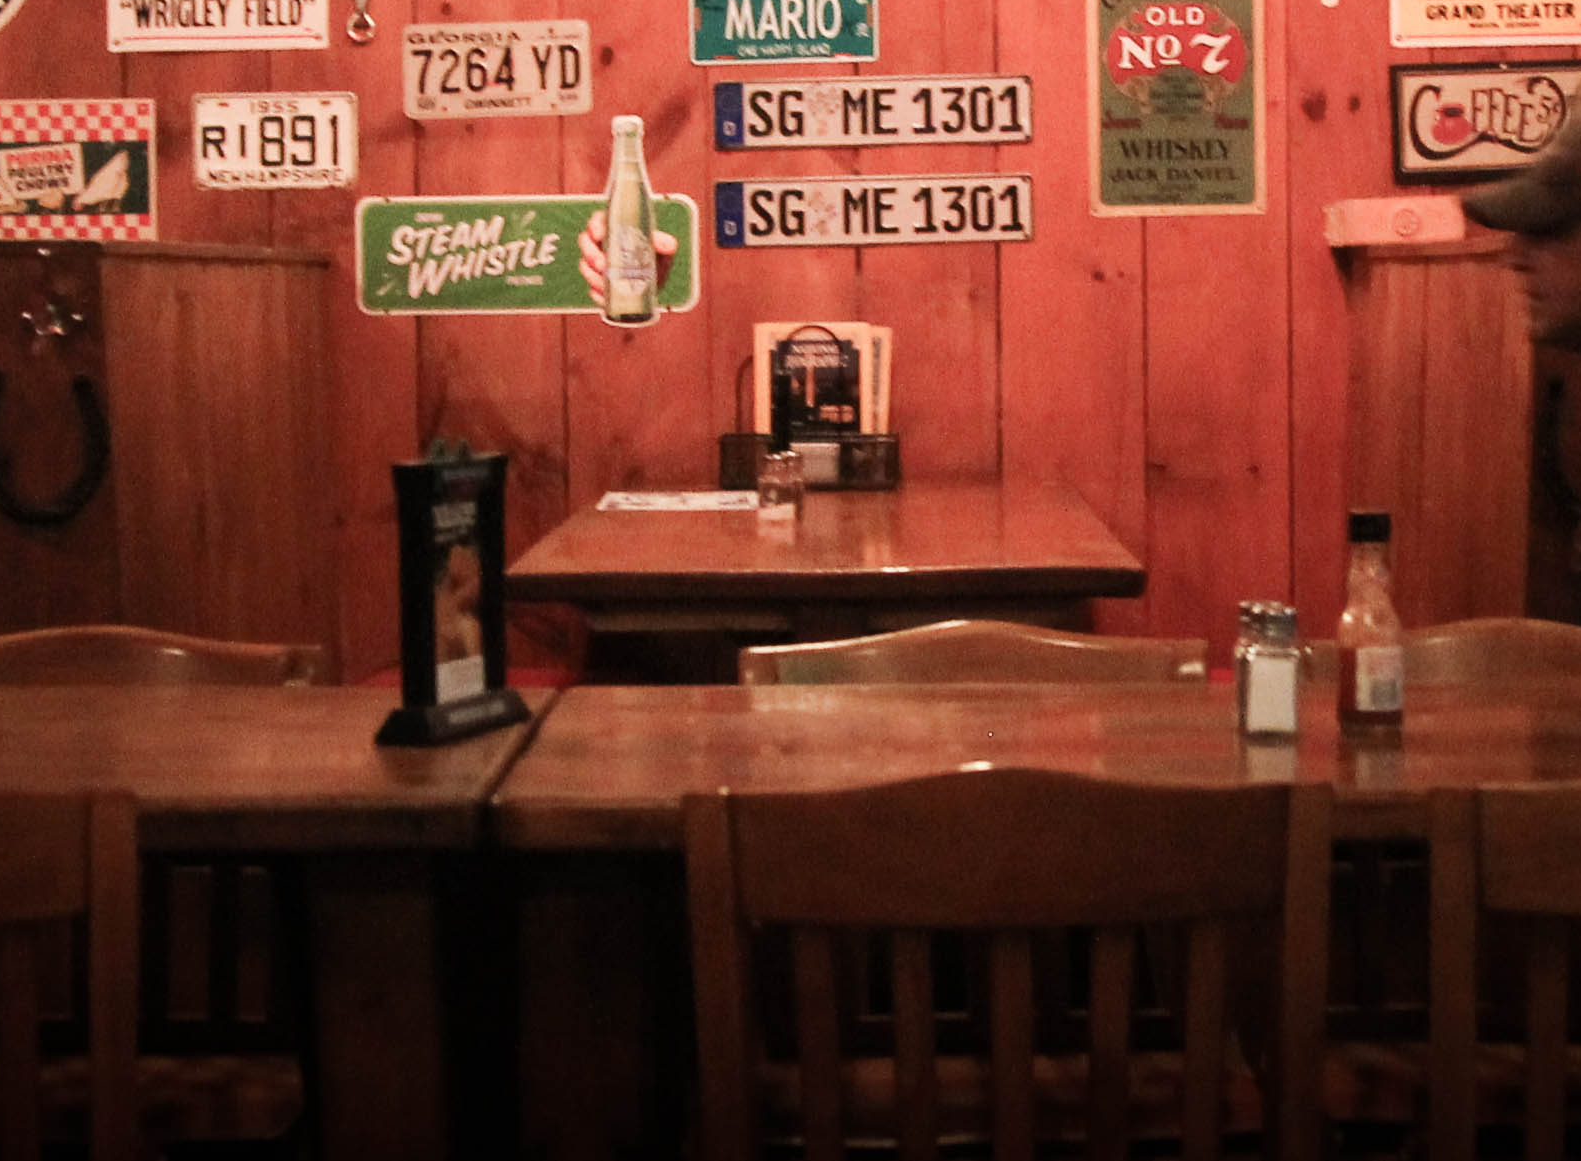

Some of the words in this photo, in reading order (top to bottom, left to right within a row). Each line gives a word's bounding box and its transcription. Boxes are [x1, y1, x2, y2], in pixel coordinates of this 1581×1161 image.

[1145, 5, 1206, 26] OLD
[1426, 3, 1485, 21] GRAND
[1496, 2, 1576, 20] THEATER
[407, 30, 521, 45] GEORGIA
[1188, 33, 1233, 74] 7
[411, 46, 517, 95] 7264
[535, 44, 581, 91] YD
[748, 90, 805, 137] SG
[842, 88, 899, 136] ME
[912, 85, 1024, 134] 1301
[1119, 138, 1230, 161] WHISKEY
[749, 189, 806, 236] SG
[843, 187, 900, 235] ME
[913, 185, 1025, 234] 1301
[386, 214, 506, 266] STEAM
[406, 232, 561, 300] WHISTLE
